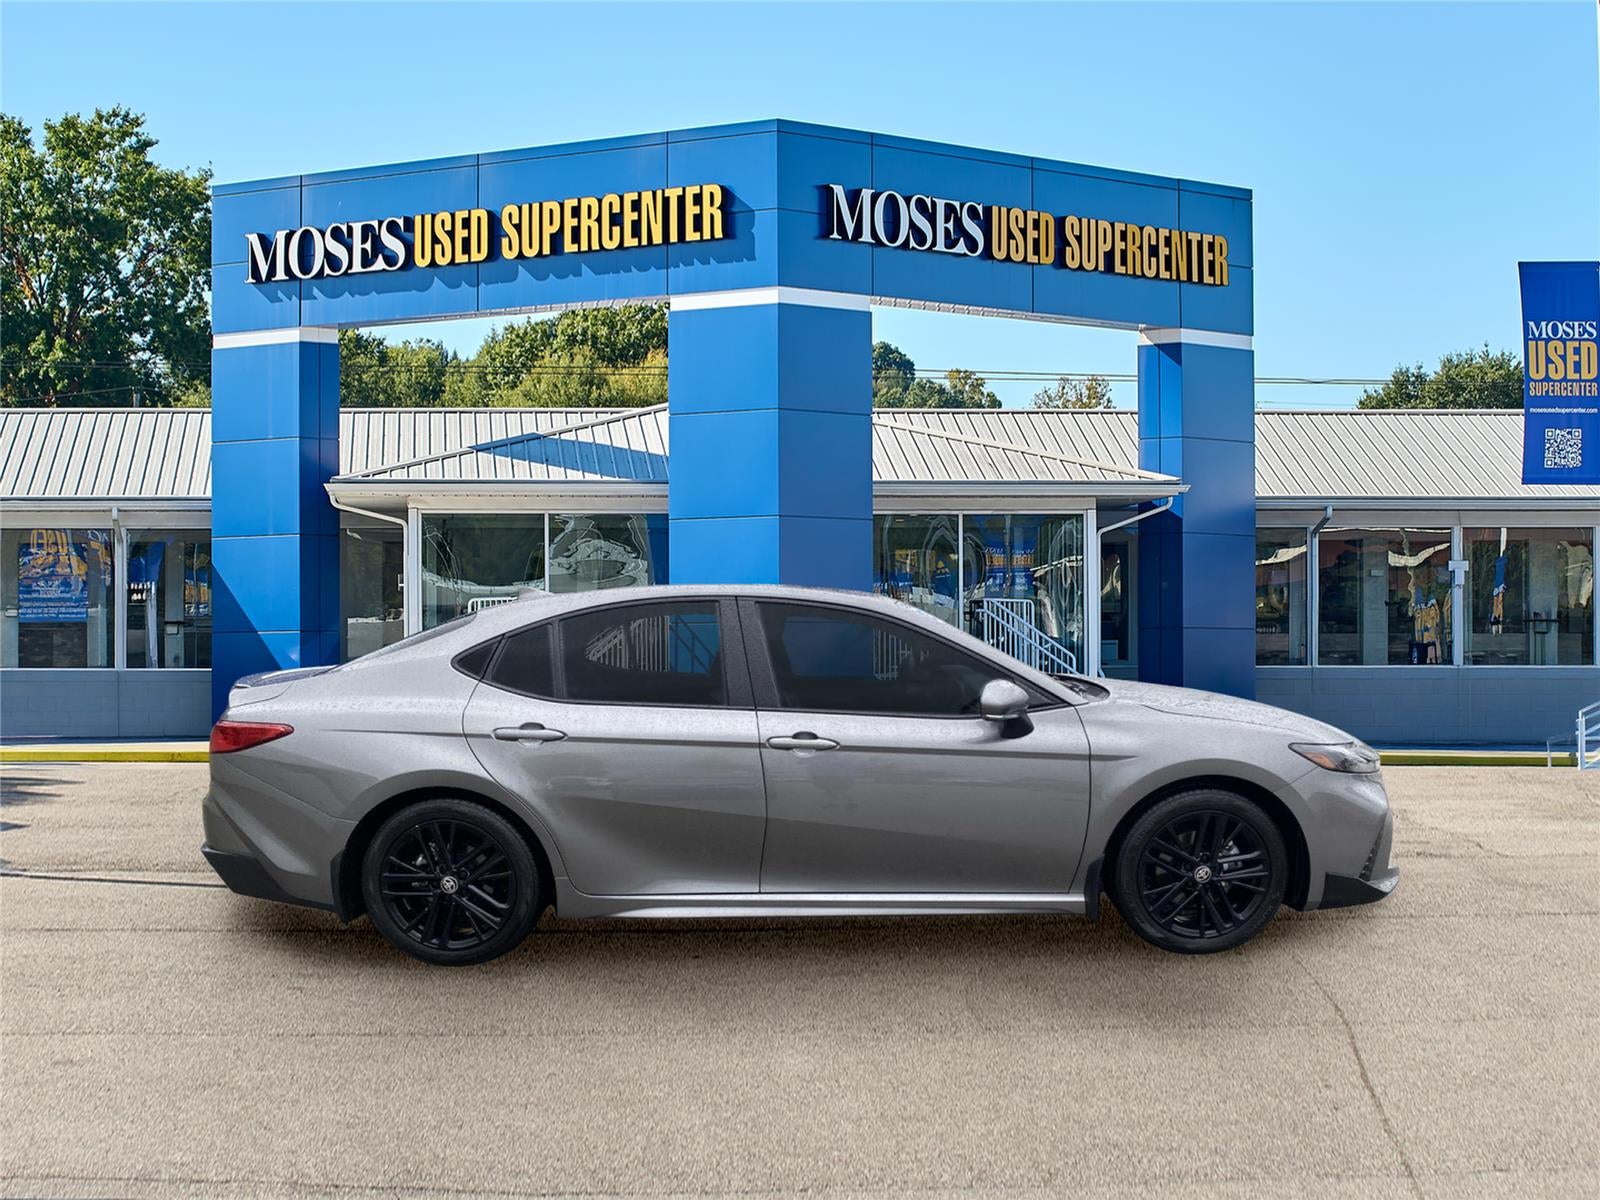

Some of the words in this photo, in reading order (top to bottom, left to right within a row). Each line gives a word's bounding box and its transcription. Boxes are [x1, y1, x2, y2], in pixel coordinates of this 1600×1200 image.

[244, 216, 406, 284] MOSES
[413, 208, 489, 268] USED
[501, 183, 724, 260] SUPERCENTER
[829, 183, 985, 257] MOSES
[991, 205, 1056, 265] USED
[1065, 215, 1230, 286] SUPERCENTER
[1527, 320, 1598, 339] MOSES
[1528, 340, 1598, 380] USED
[1529, 381, 1598, 396] SUPERCENTER
